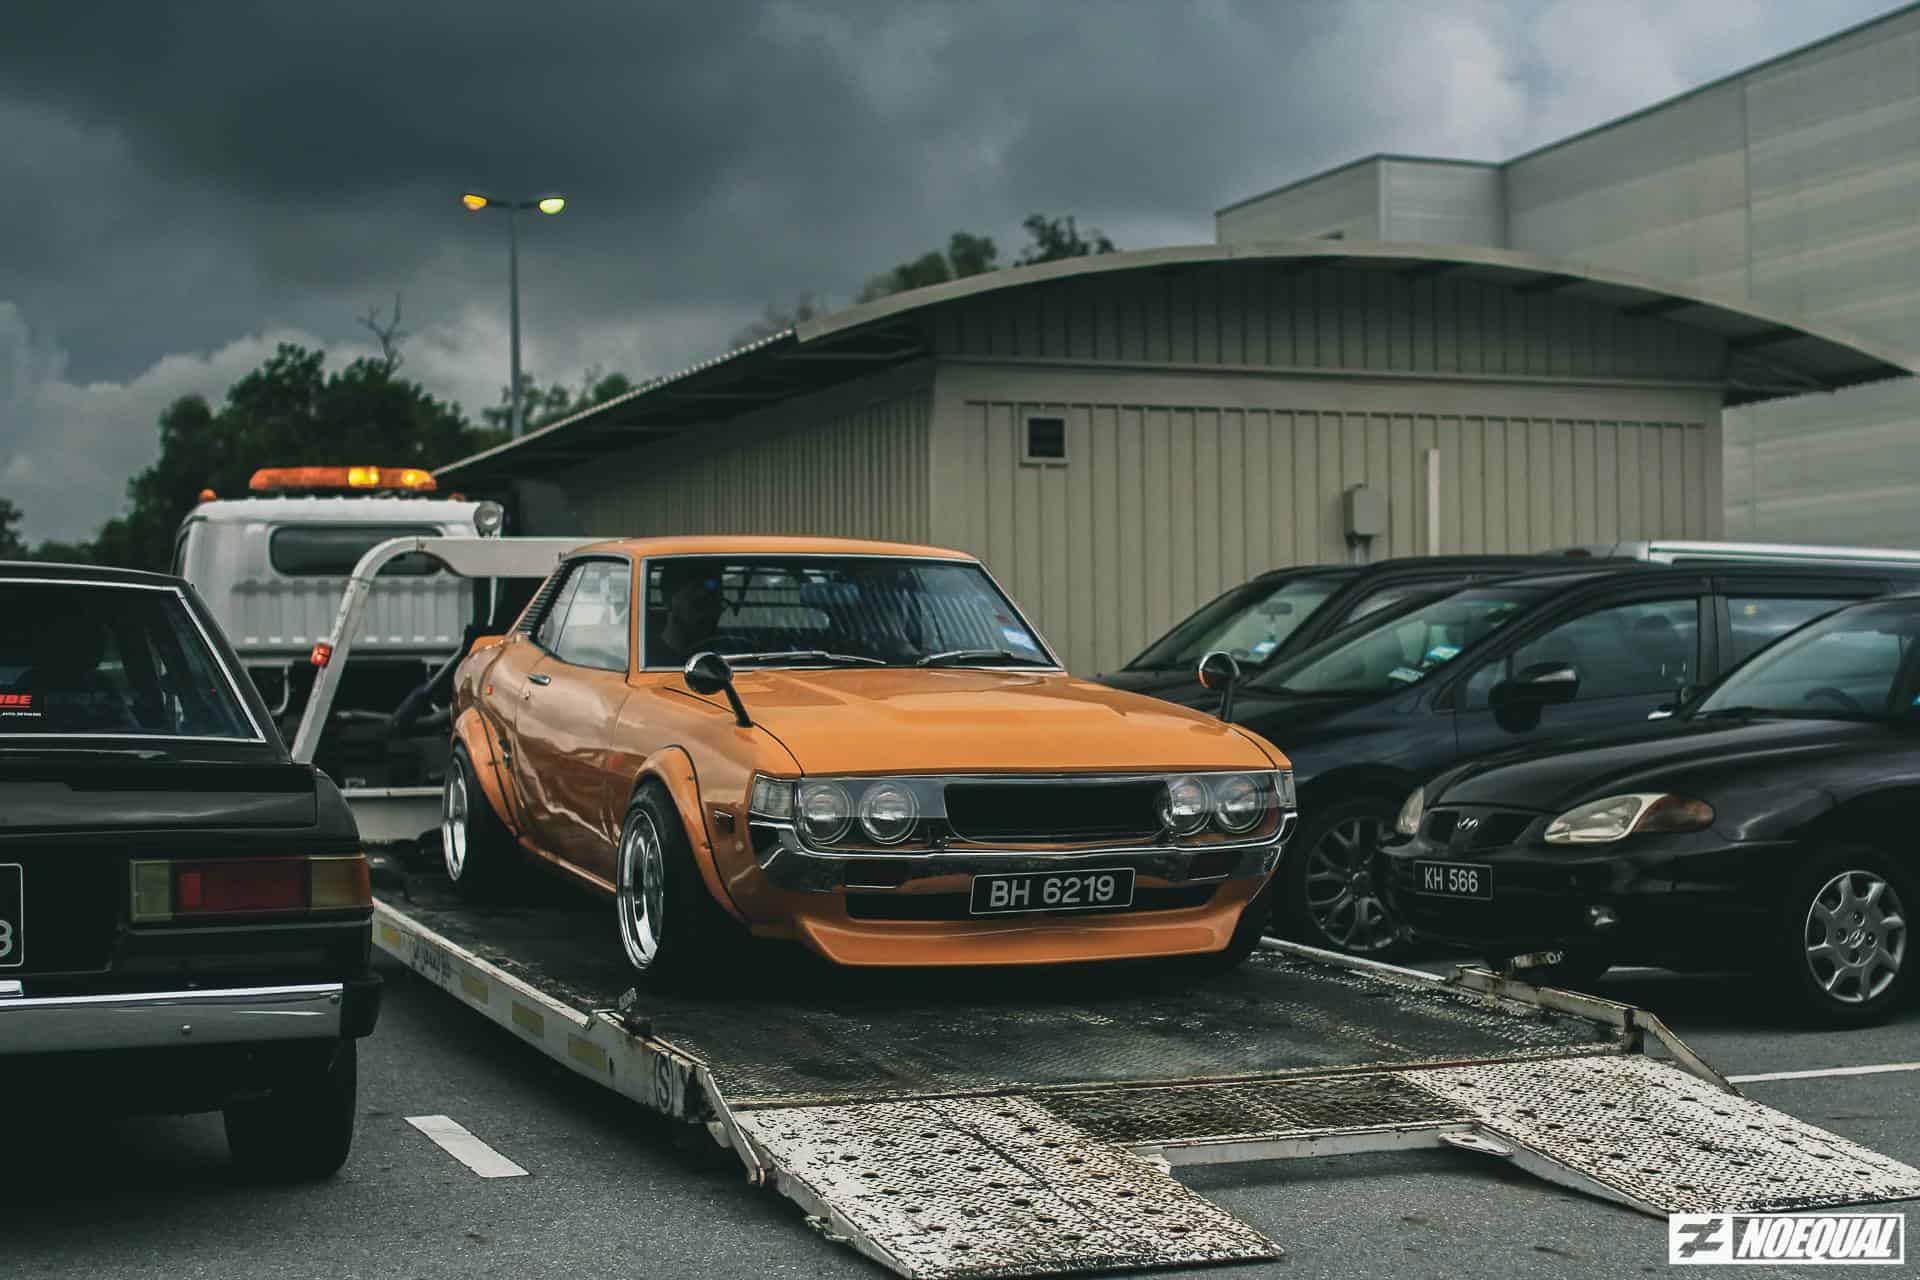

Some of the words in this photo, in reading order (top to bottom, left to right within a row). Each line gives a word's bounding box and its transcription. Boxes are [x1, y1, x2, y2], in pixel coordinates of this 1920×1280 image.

[989, 879, 1031, 907] BH
[1042, 875, 1115, 904] 6219
[1424, 866, 1443, 890] KH
[1448, 868, 1478, 893] 566
